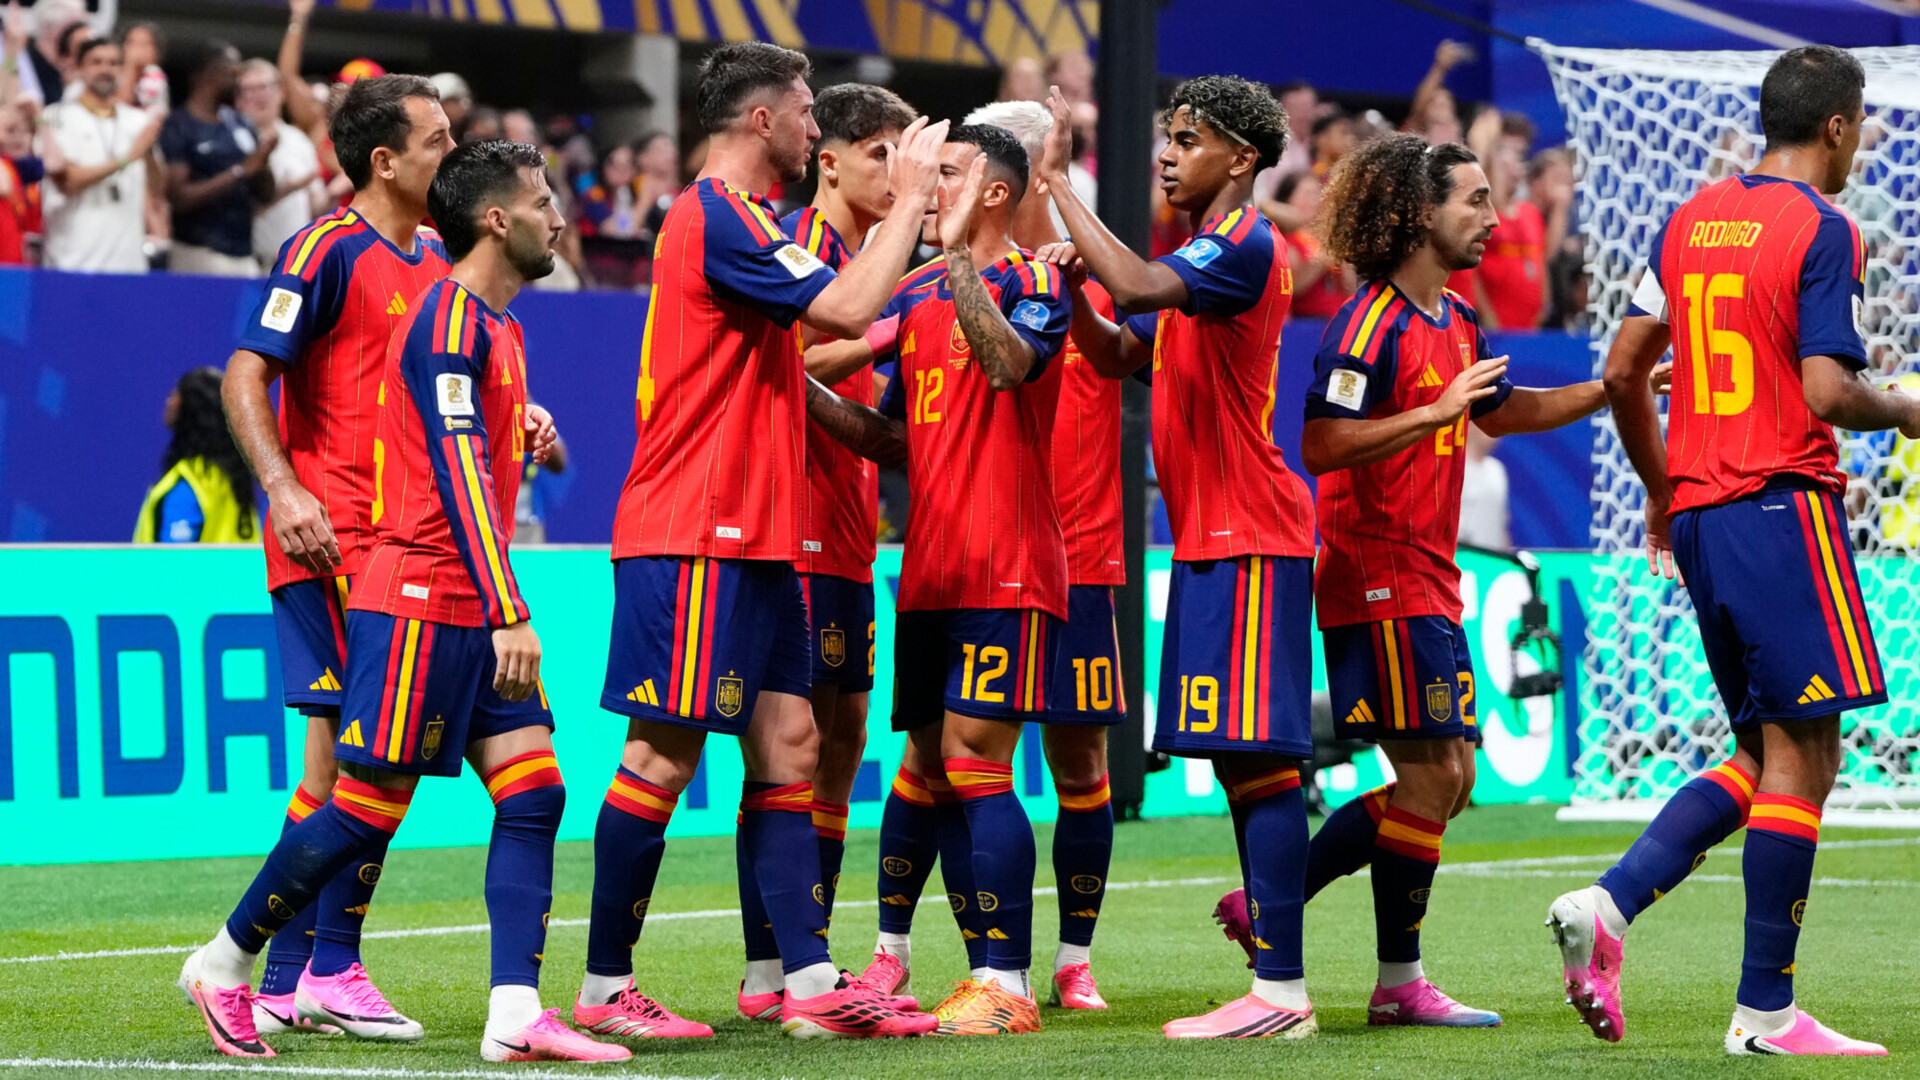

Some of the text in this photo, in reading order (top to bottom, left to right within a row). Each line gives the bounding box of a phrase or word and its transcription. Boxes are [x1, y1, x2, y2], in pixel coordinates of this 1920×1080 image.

[1688, 220, 1763, 248] RODRIGO
[1683, 273, 1755, 415] 16
[914, 367, 944, 425] 12
[960, 643, 1009, 702] 12
[1072, 656, 1113, 711] 10
[1178, 675, 1219, 733] 19
